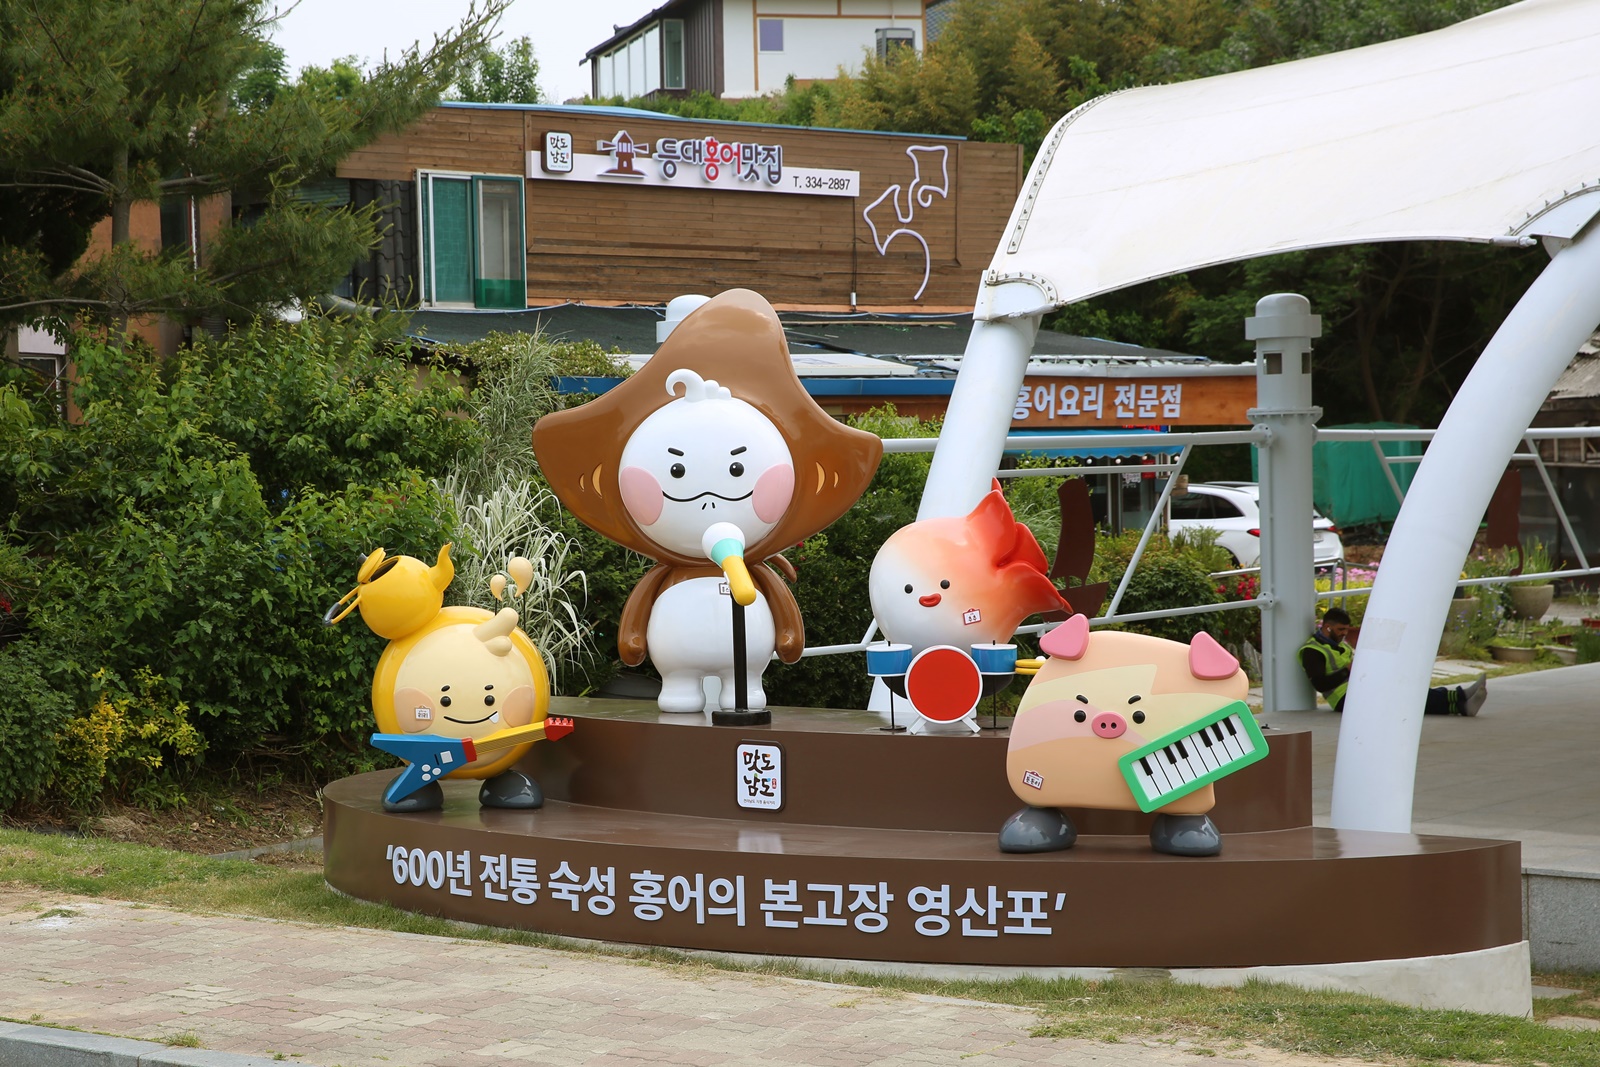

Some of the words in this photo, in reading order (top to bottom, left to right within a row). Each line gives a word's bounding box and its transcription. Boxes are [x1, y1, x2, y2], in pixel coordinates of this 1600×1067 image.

[550, 136, 568, 150] 맛도
[550, 150, 568, 163] 남도
[656, 136, 782, 187] 등대홍어맛집
[805, 177, 850, 191] 334-2897
[1012, 383, 1105, 420] 홍어요리
[1114, 383, 1182, 419] 전문점
[743, 749, 775, 774] 맛도
[743, 773, 775, 797] 남도
[479, 853, 541, 905] 전통
[548, 861, 616, 916] 숙성
[628, 870, 746, 927] 홍어의
[760, 879, 894, 934] 본고장
